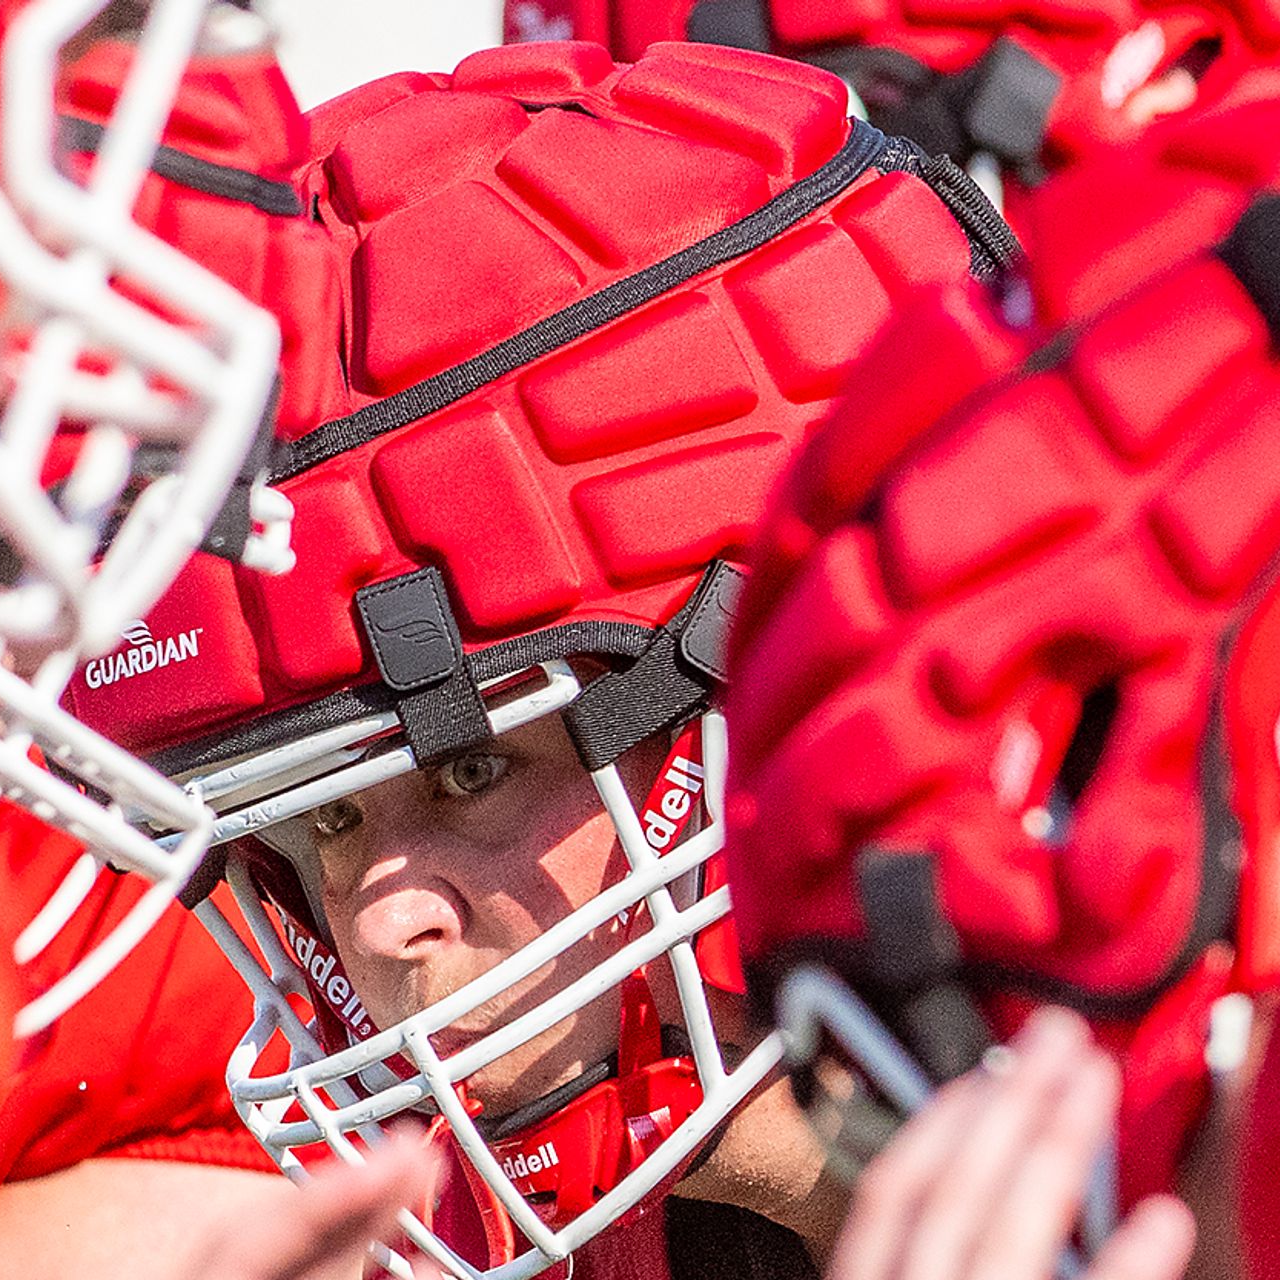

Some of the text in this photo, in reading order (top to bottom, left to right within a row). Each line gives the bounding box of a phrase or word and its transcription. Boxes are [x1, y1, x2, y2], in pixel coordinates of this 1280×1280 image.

[85, 629, 199, 689] GUARDIAN
[643, 755, 705, 849] dell
[503, 1141, 559, 1180] ddell
